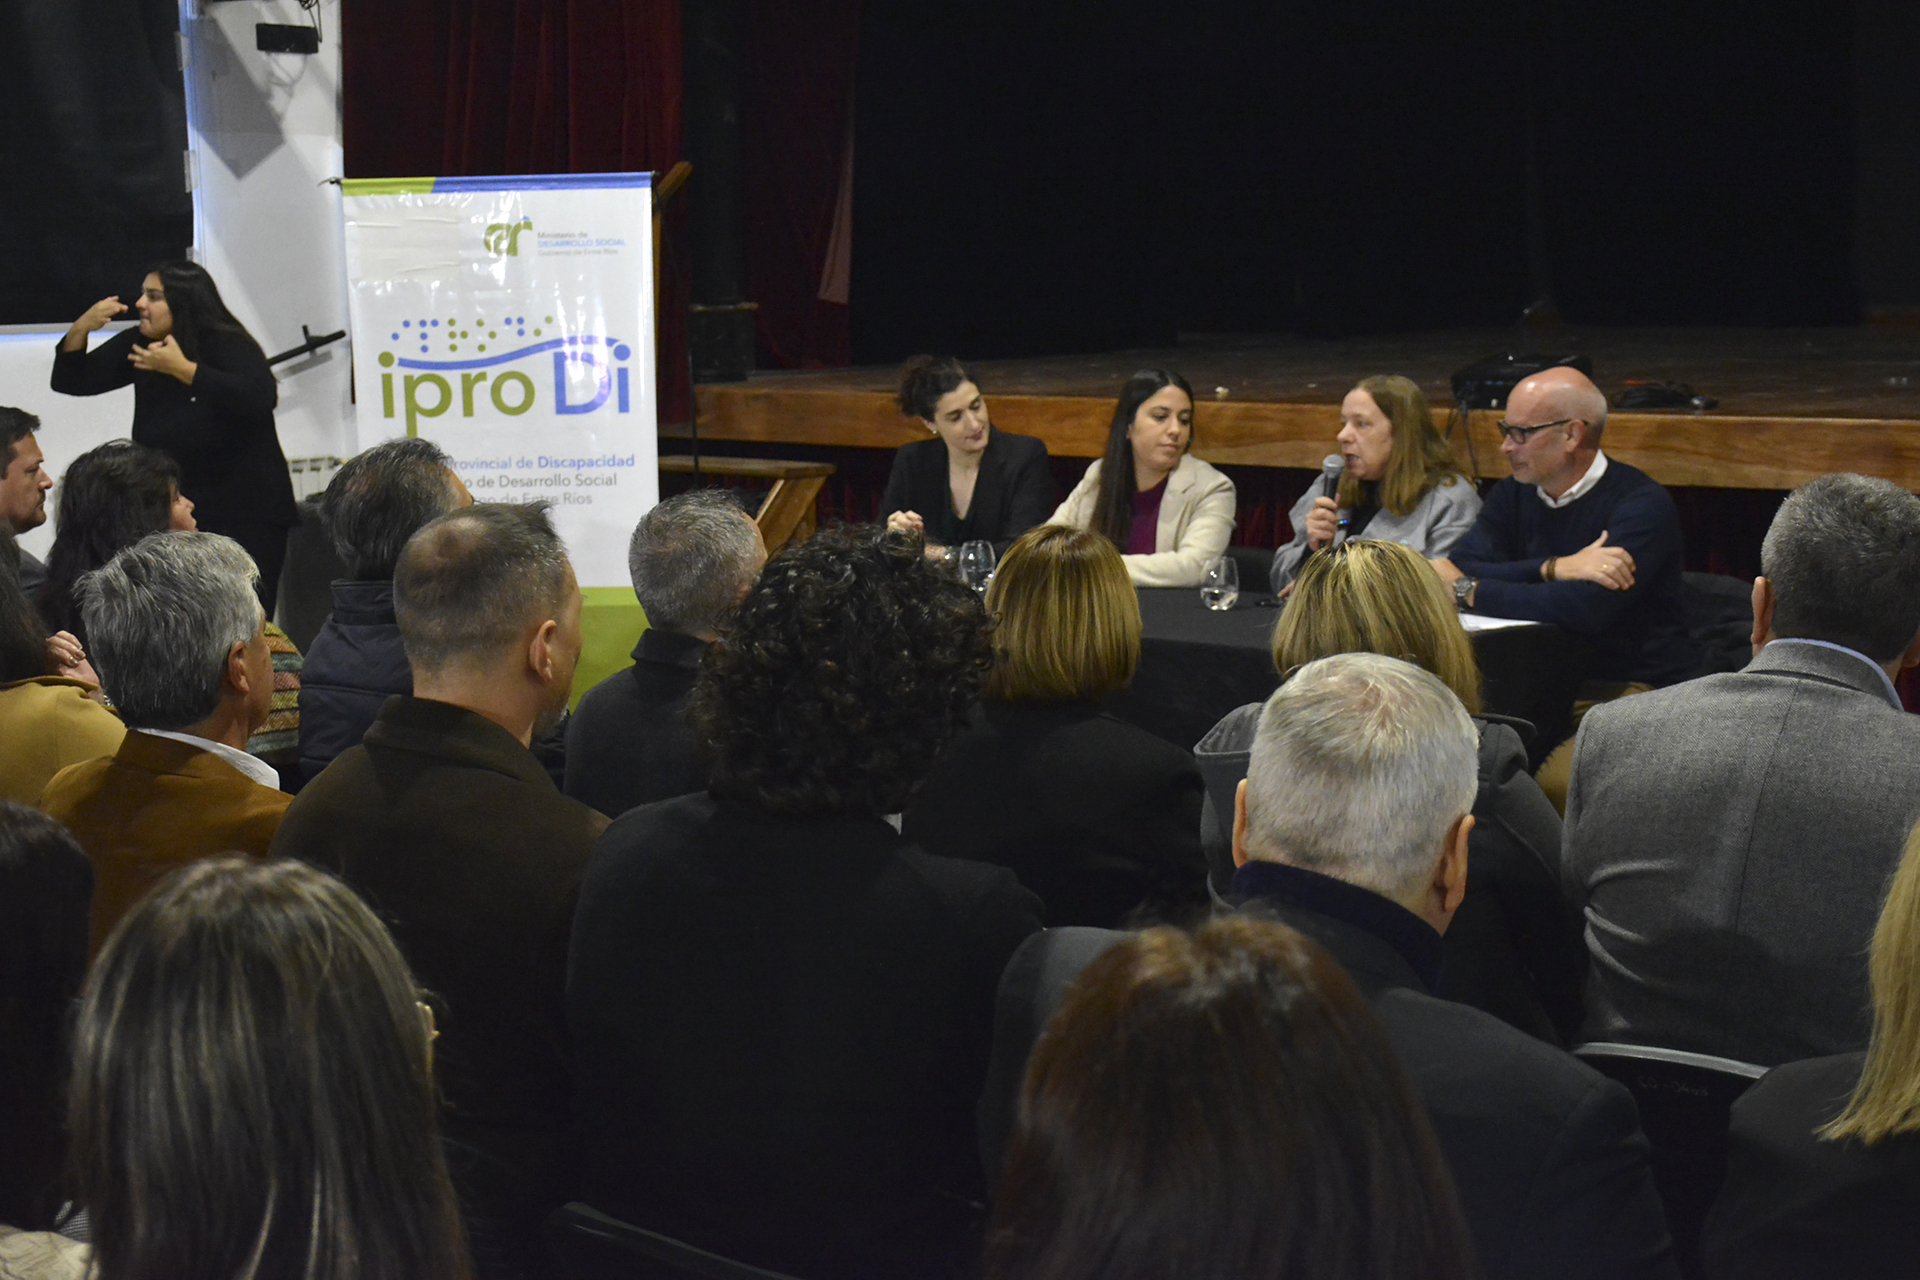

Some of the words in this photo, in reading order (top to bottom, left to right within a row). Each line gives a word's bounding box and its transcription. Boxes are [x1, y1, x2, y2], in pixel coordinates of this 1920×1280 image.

[538, 239, 593, 248] DESARROLLO
[595, 238, 626, 247] SOCIAL
[516, 456, 534, 469] de
[538, 454, 635, 471] Discapacidad
[476, 475, 495, 488] de
[499, 473, 571, 488] Desarrollo
[575, 472, 617, 487] Social
